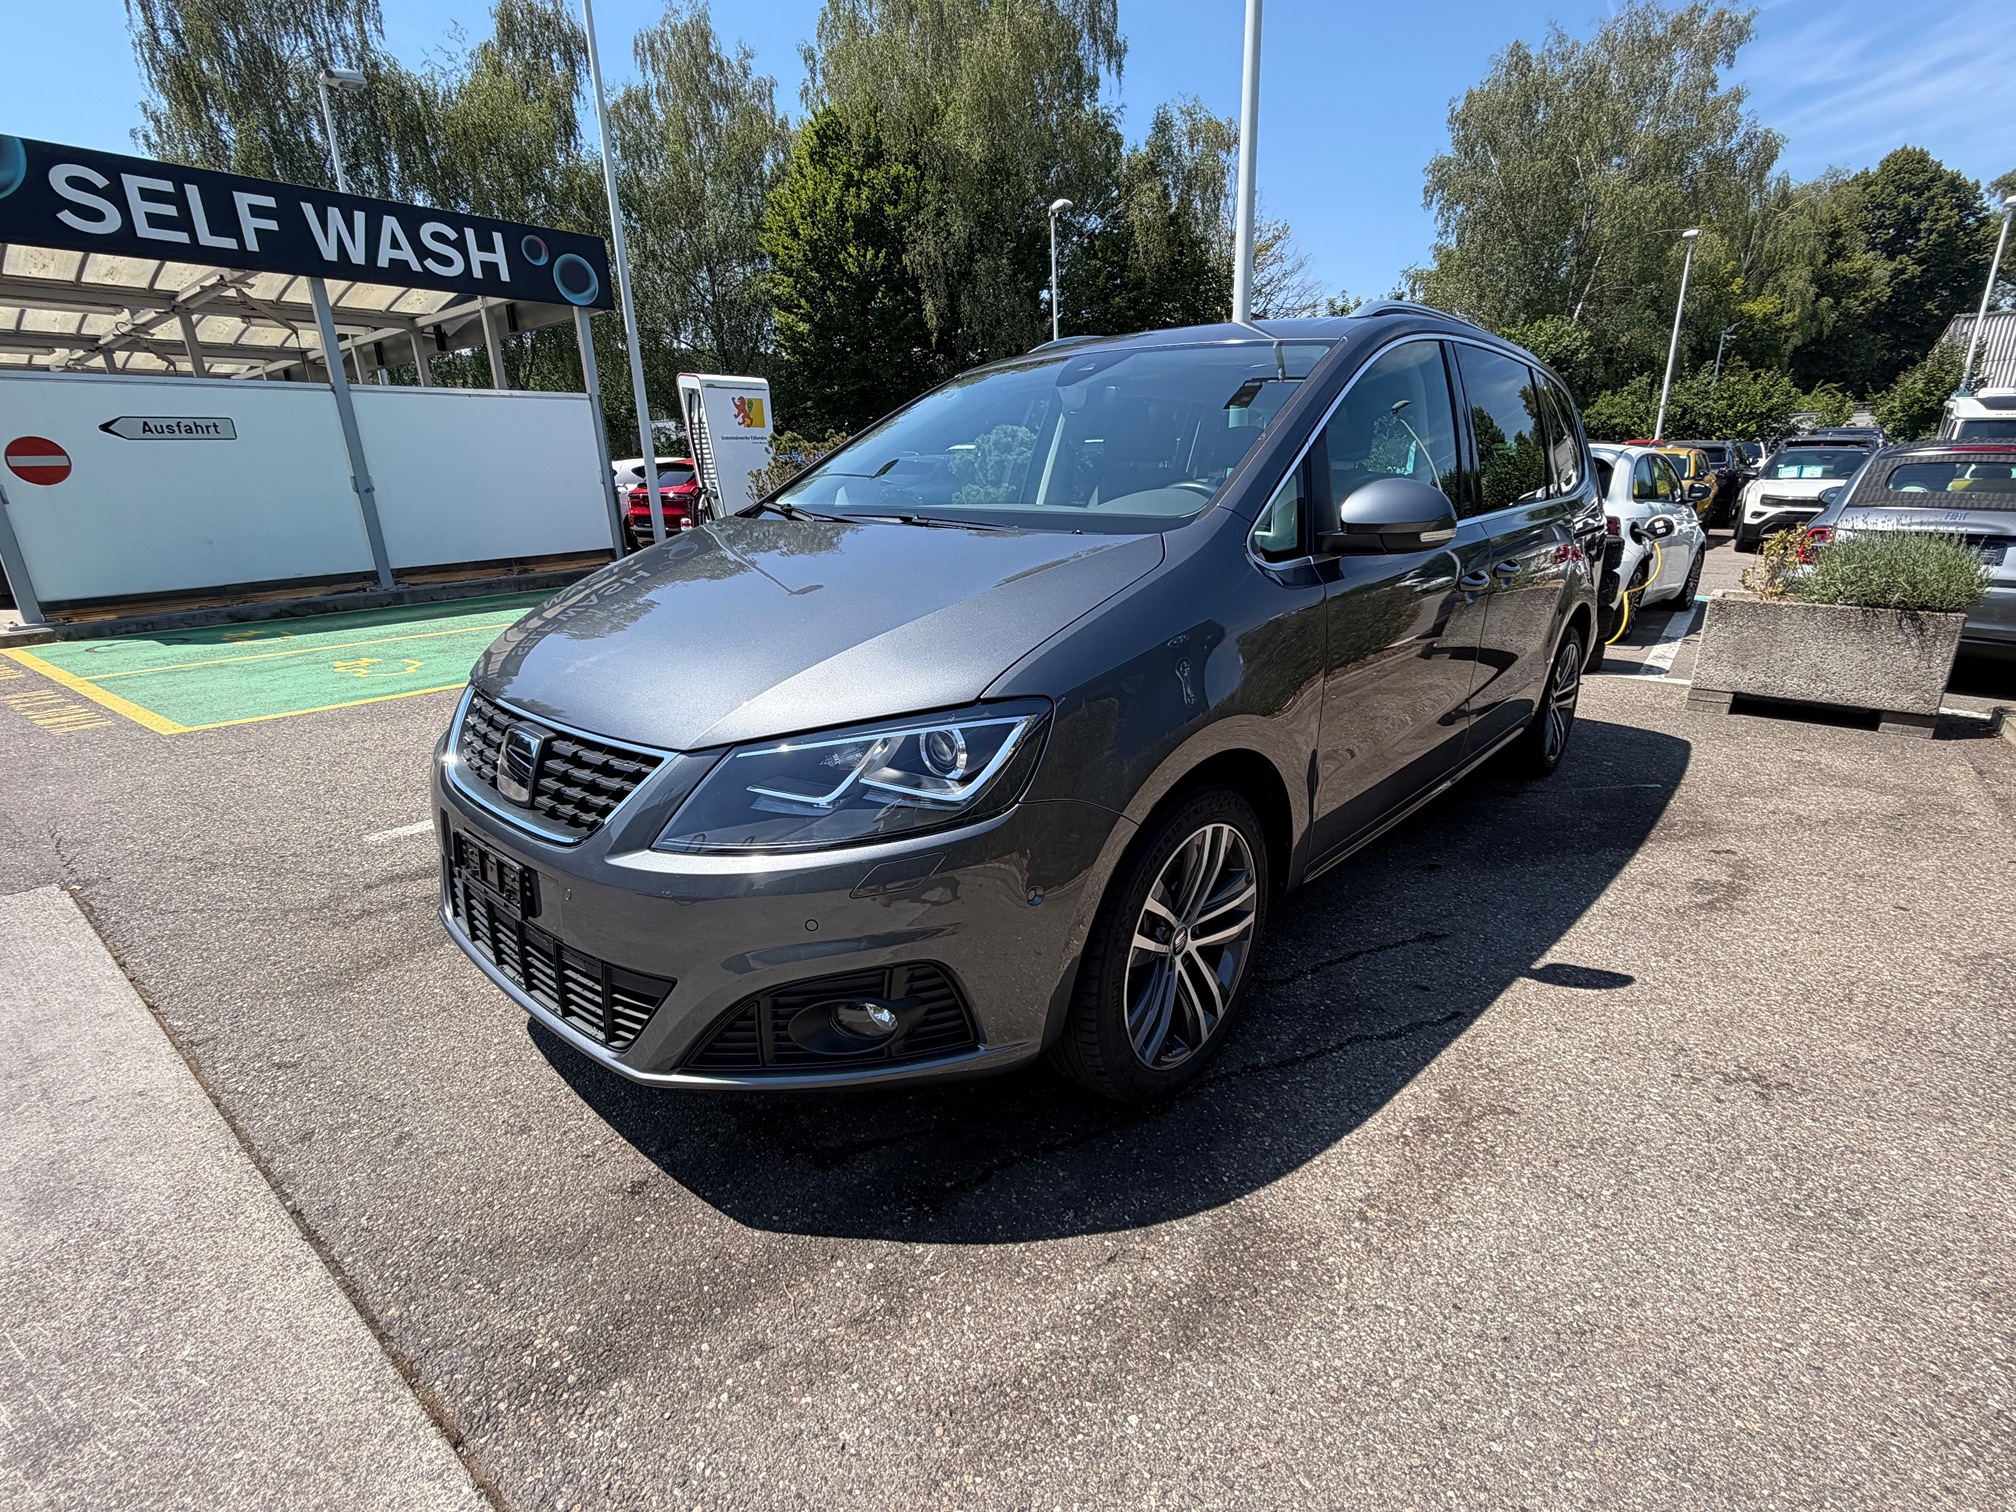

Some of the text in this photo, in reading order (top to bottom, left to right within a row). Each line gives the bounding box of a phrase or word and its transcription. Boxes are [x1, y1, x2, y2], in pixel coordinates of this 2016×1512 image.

[48, 163, 511, 283] SELF WASH
[142, 420, 221, 435] Ausfahrt
